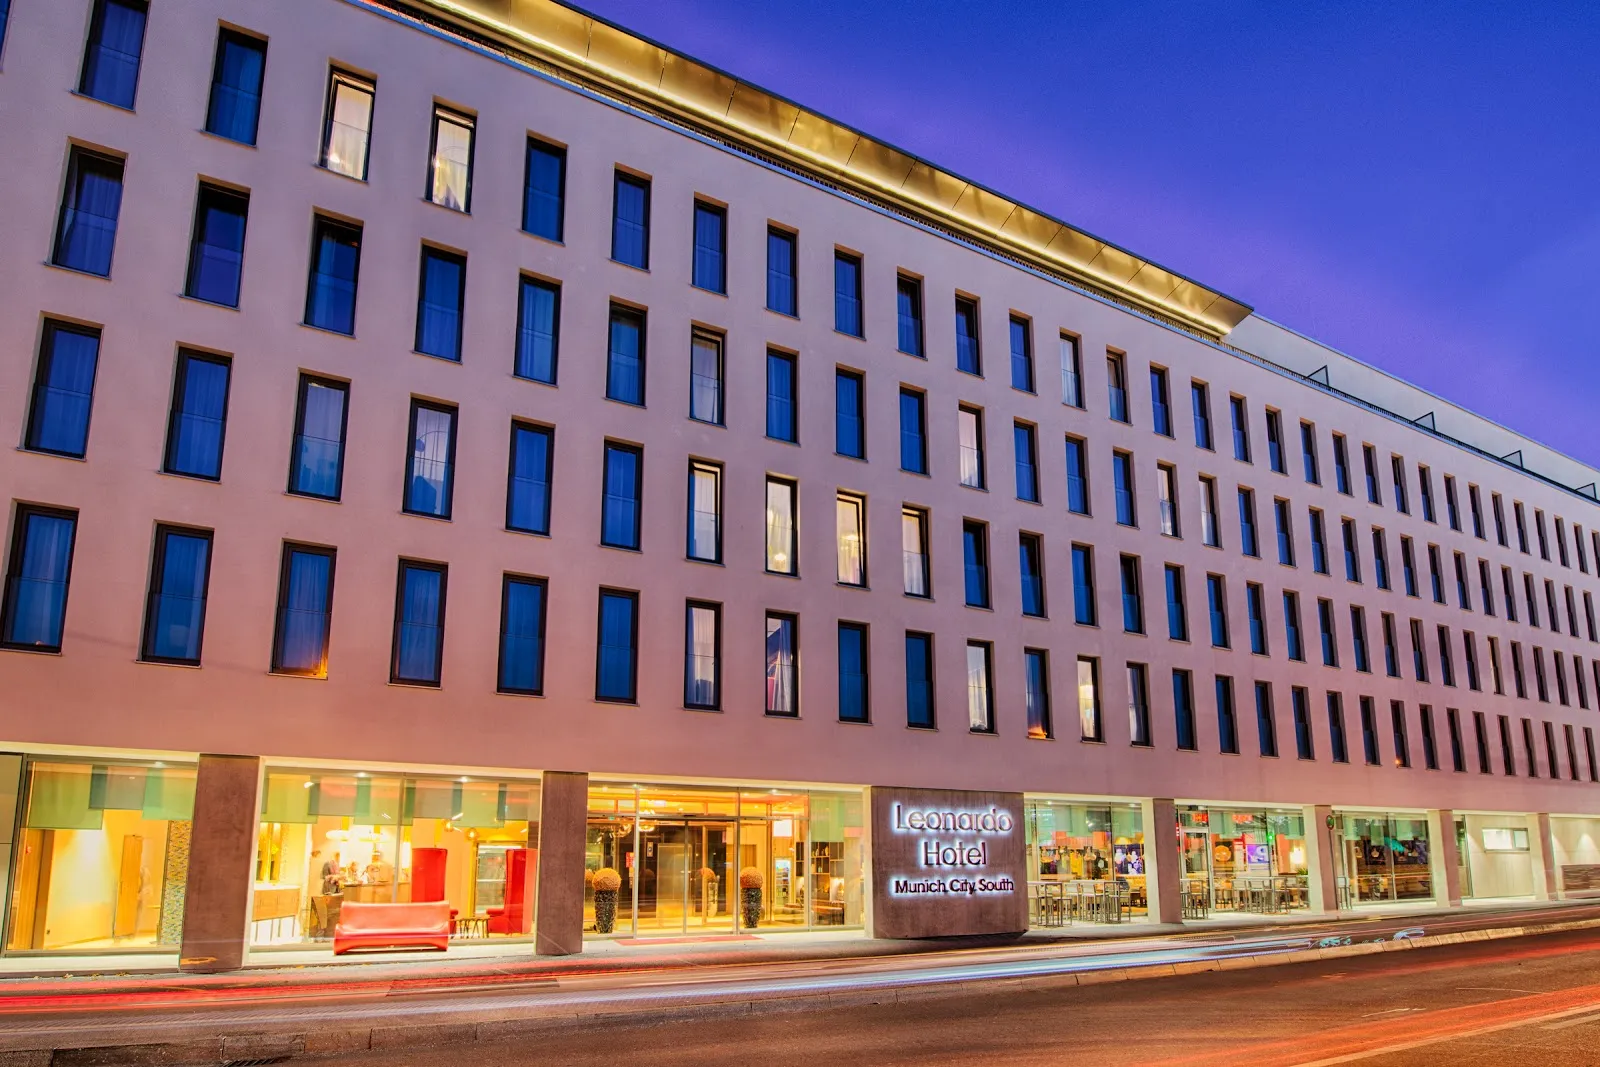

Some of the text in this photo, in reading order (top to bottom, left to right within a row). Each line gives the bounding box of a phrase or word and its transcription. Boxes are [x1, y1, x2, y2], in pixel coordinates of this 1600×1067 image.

[896, 804, 1013, 832] Leonardo
[924, 841, 987, 866] Hotel
[894, 878, 1014, 894] Munich City South
